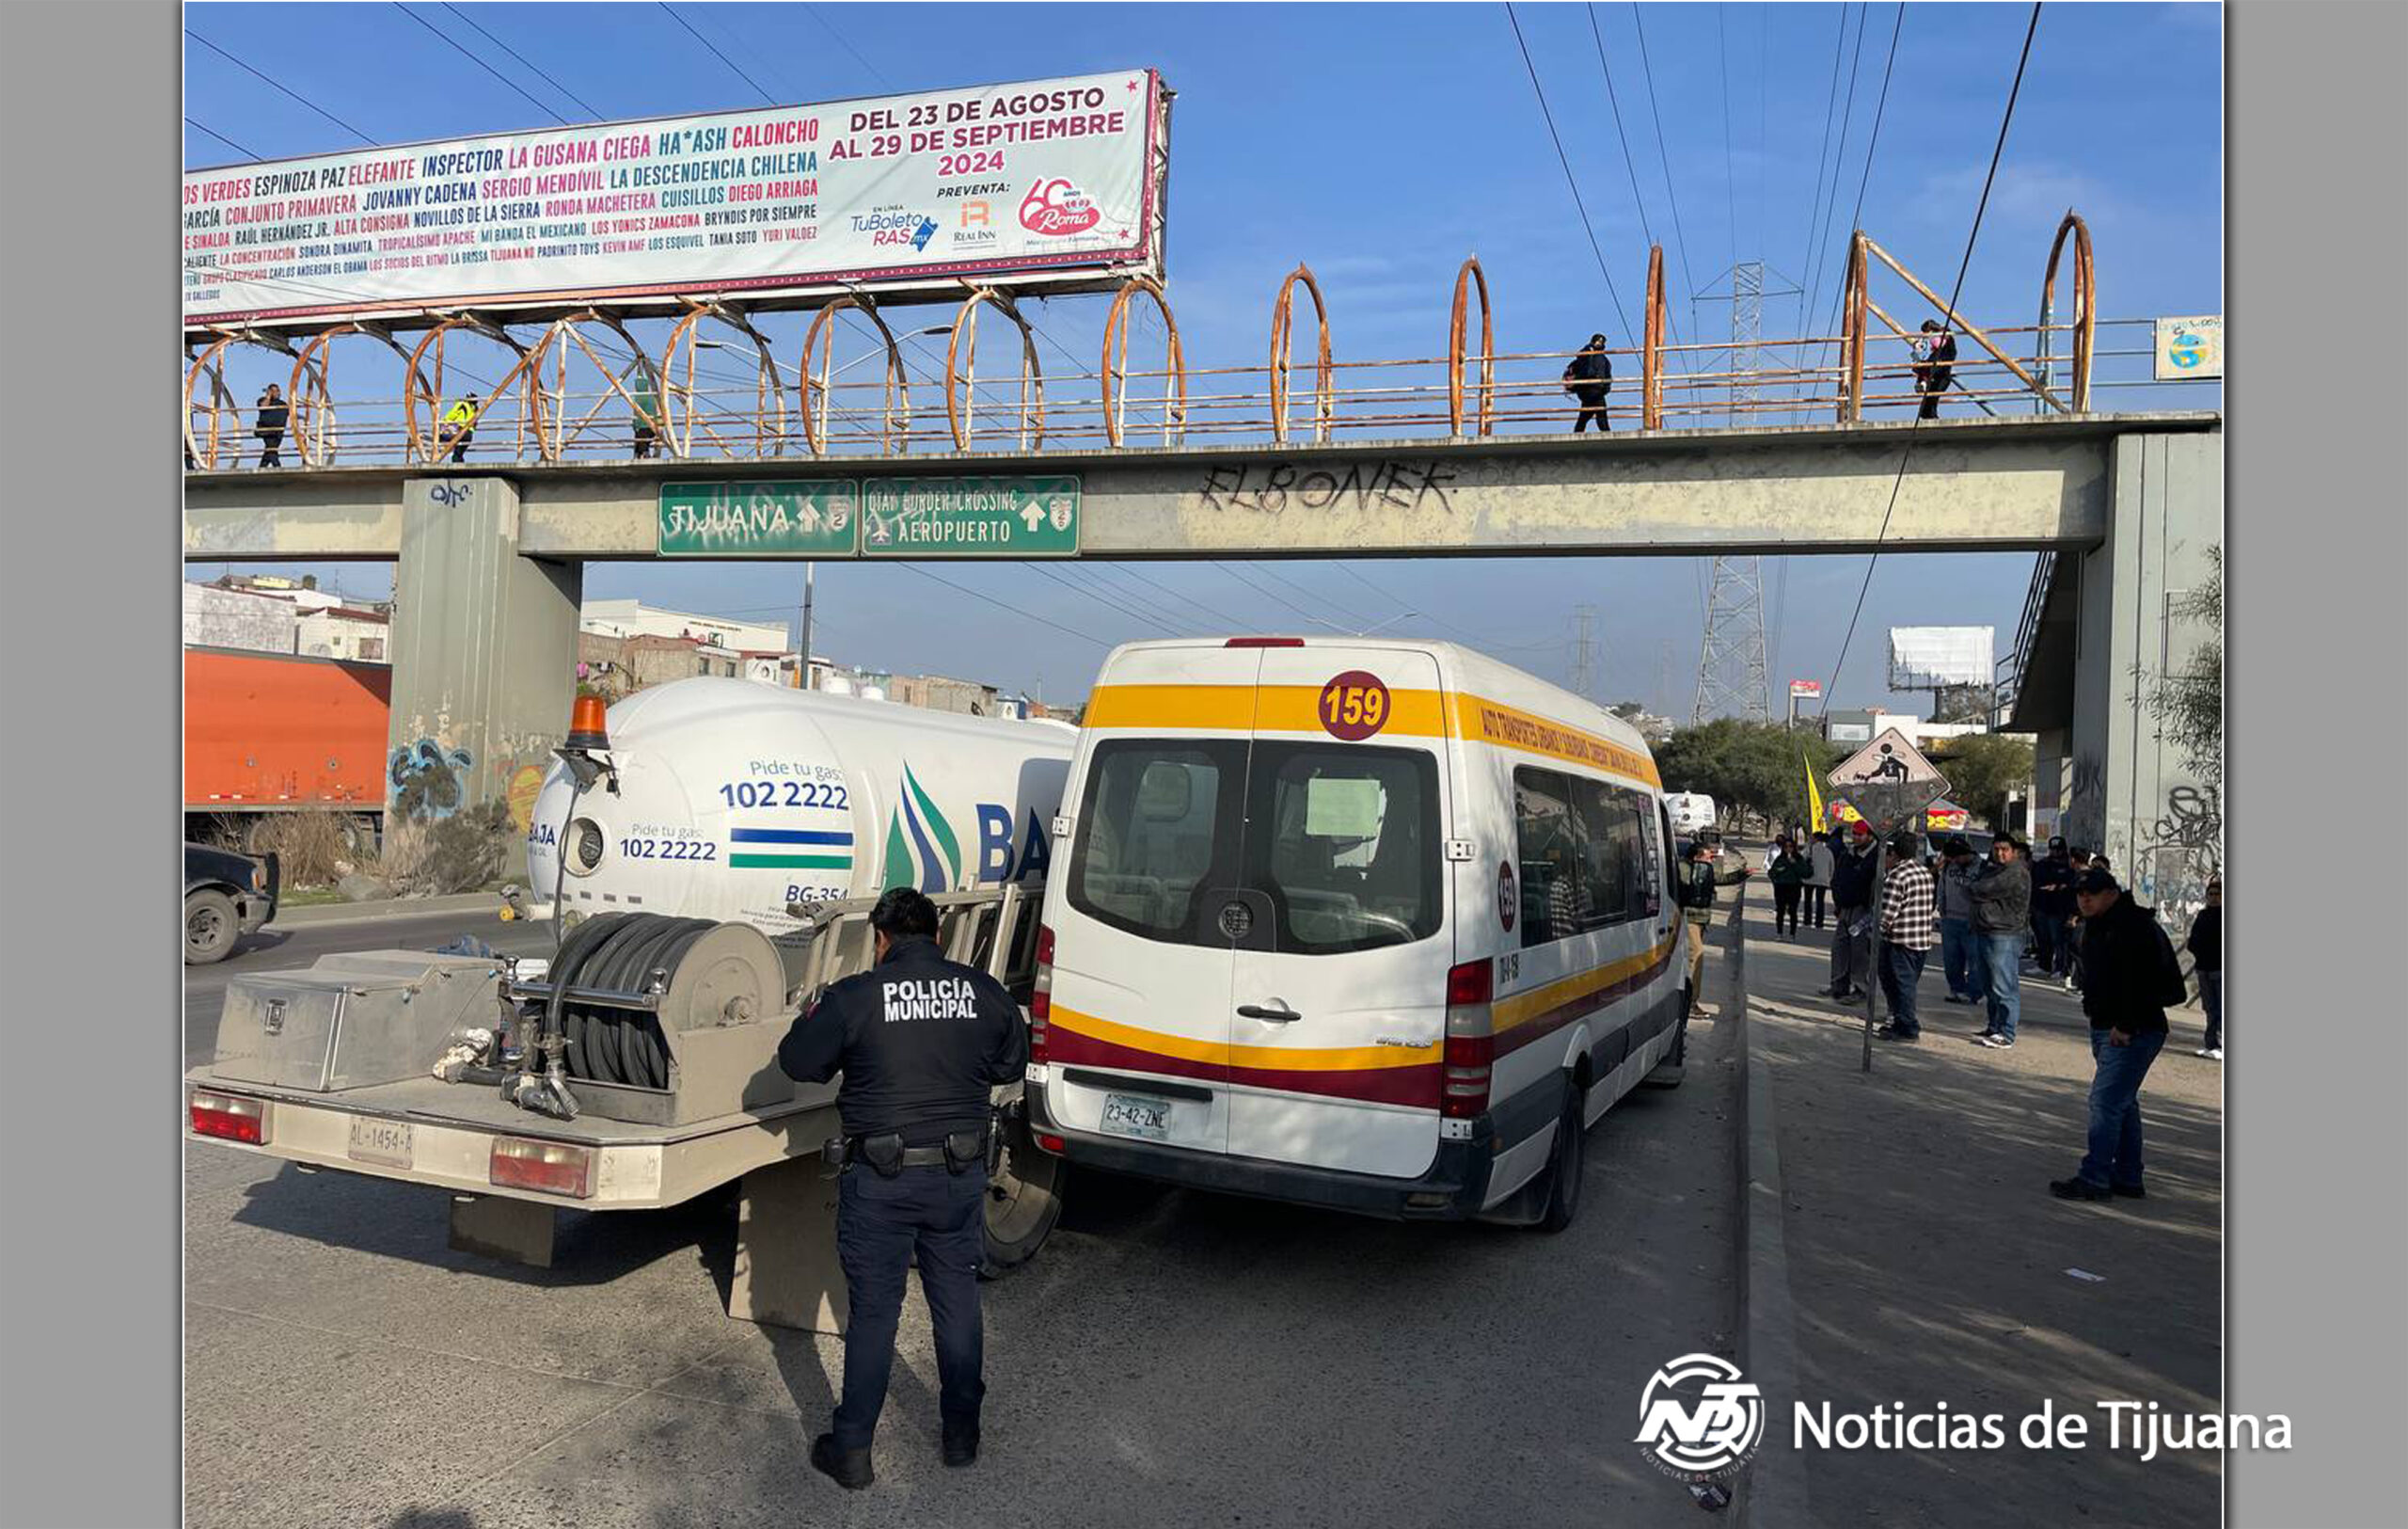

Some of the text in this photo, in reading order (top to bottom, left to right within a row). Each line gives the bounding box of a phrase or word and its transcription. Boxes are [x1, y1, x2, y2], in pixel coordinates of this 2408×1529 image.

[850, 87, 1105, 133] DEL 23 DE AGOSTO
[829, 111, 1125, 160] AL 29 DE SEPTIEMBRE
[202, 178, 251, 202] VERDES
[255, 170, 316, 197] ESPINOZA
[321, 167, 346, 189] PAZ
[349, 159, 416, 186] ELEFANTE
[422, 149, 503, 178] INSPECTOR
[509, 147, 528, 169] LA
[533, 139, 597, 167] GUSANA
[603, 135, 651, 161] CIEGA
[733, 119, 818, 149] CALONCHO
[938, 151, 1005, 176] 2024
[226, 201, 285, 226] CONJUNTO
[288, 194, 357, 219] PRIMAVERA
[362, 187, 421, 211] JOVANNY
[424, 182, 477, 205] CADENA
[483, 176, 531, 199] SERGIO
[536, 169, 605, 195] MENDÍVIL
[610, 168, 628, 188] LA
[633, 157, 746, 187] DESCENDENCIA
[752, 151, 817, 177] CHILENA
[937, 182, 1011, 199] PREVENTA:
[193, 231, 230, 249] SINALOA
[235, 227, 259, 245] RAÚL
[261, 223, 312, 243] HERNÁNDEZ
[314, 222, 331, 239] JR.
[334, 218, 357, 236] ALTA
[360, 213, 410, 233] CONSIGNA
[414, 208, 464, 228] NOVILLOS
[467, 206, 481, 223] DE
[484, 205, 498, 222] LA
[500, 201, 540, 220] SIERRA
[546, 198, 583, 217] RONDA
[587, 192, 656, 214] MACHETERA
[661, 186, 724, 208] CUISILLOS
[729, 183, 763, 202] DIEGO
[767, 179, 817, 199] ARRIAGA
[851, 213, 923, 232] TuBoleto
[1037, 208, 1090, 231] Roma
[220, 253, 230, 265] LA
[299, 244, 331, 259] SONORA
[333, 240, 372, 255] DINAMITA
[443, 231, 475, 245] APACHE
[481, 229, 493, 243] MI
[495, 227, 524, 242] BANDA
[527, 226, 536, 239] EL
[539, 222, 586, 238] MEXICANO
[592, 220, 610, 235] LOS
[612, 217, 645, 233] YONICS
[649, 214, 700, 231] ZAMACONA
[705, 209, 747, 226] BRYNDIS
[750, 208, 769, 223] POR
[771, 203, 816, 221] SIEMPRE
[872, 229, 911, 247] RAS
[269, 265, 295, 279] CARLOS
[333, 263, 341, 275] EL
[452, 253, 460, 264] LA
[490, 248, 522, 262] TIJUANA
[579, 243, 600, 255] TOYS
[648, 237, 663, 250] LOS
[666, 234, 705, 249] ESQUIVEL
[709, 232, 734, 246] TANIA
[736, 231, 757, 245] SOTO
[763, 229, 783, 242] YURI
[785, 226, 817, 240] VALDEZ
[958, 490, 1017, 511] CROSSING
[672, 504, 789, 532] TIJUANA
[833, 512, 843, 527] 2
[897, 520, 1010, 543] AEROPUERTO
[1323, 685, 1385, 727] 159
[751, 760, 789, 776] Pide
[794, 762, 812, 776] tu
[719, 782, 850, 811] 102 2222
[632, 823, 658, 836] Pide
[662, 825, 675, 837] tu
[620, 838, 717, 861] 102 2222
[882, 977, 976, 1003] POLICÍA
[884, 998, 977, 1023] MUNICIPAL
